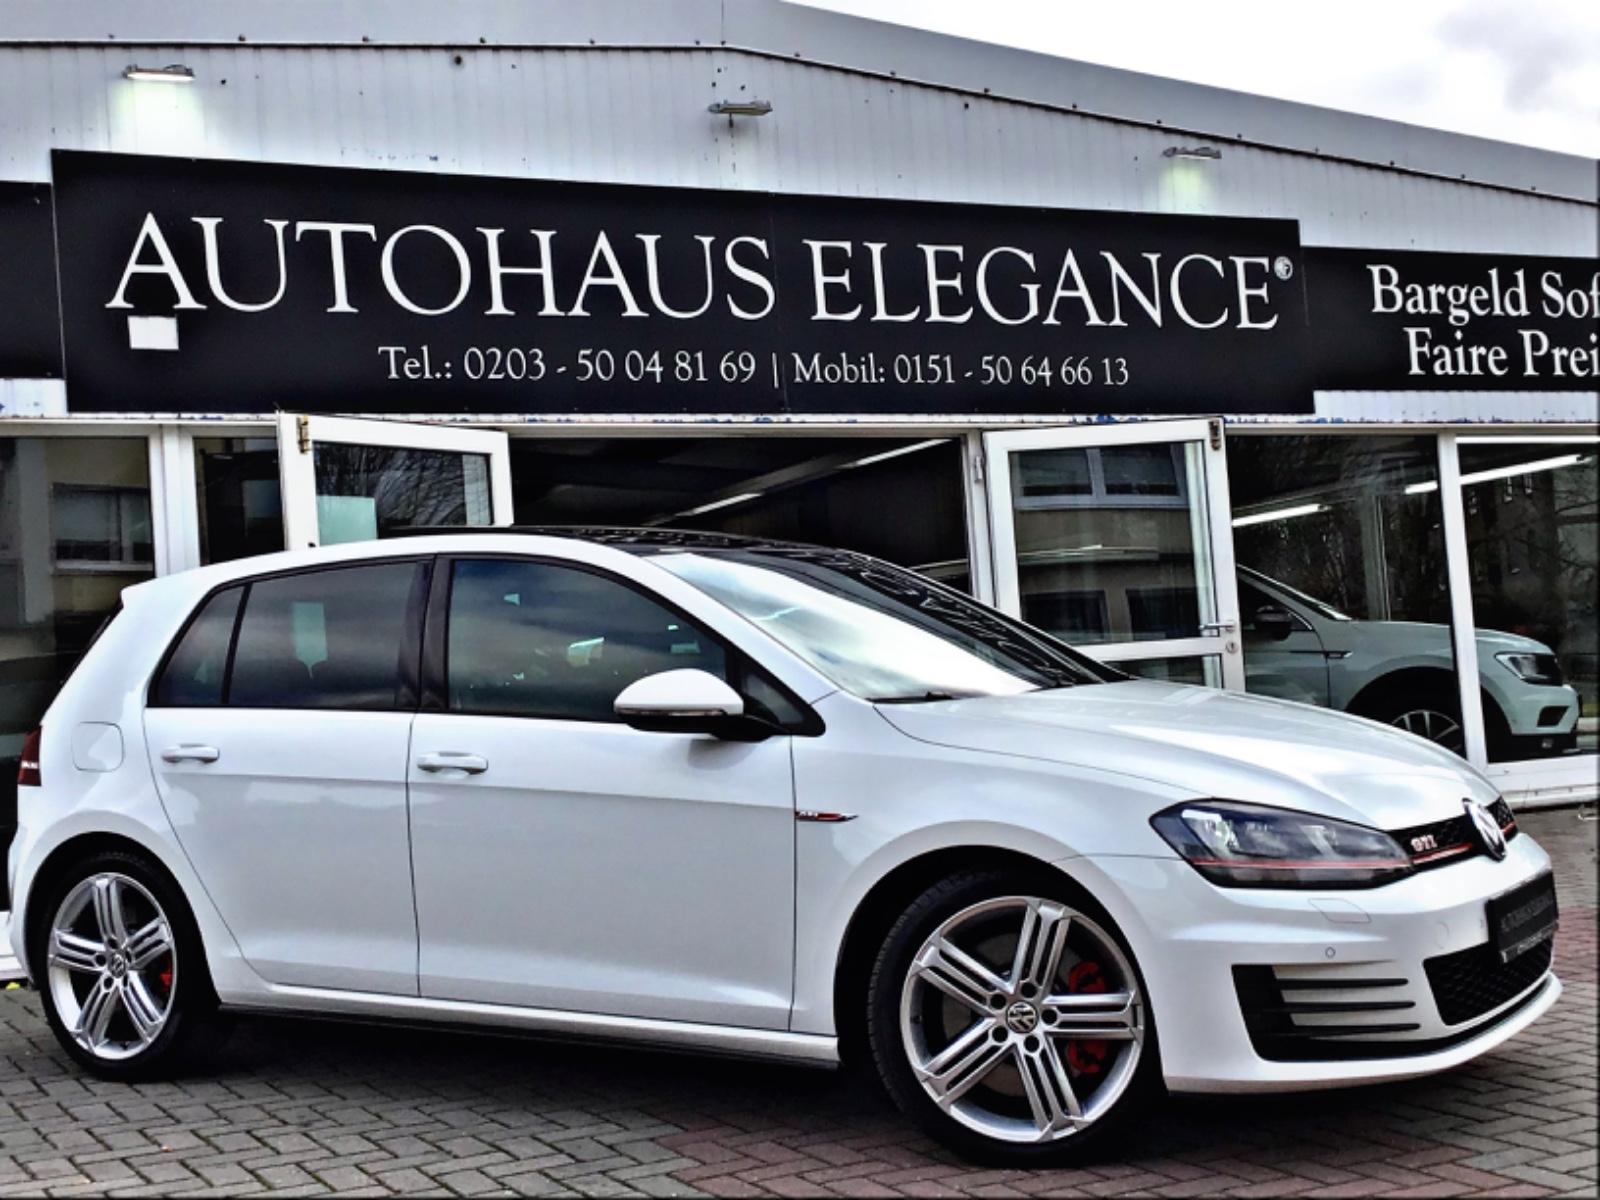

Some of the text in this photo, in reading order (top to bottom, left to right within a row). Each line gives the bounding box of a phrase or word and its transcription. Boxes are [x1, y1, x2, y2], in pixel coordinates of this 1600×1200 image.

[105, 212, 775, 320] AUTOHAUS
[1366, 264, 1531, 327] Bargeld
[377, 346, 452, 379] Tel.:
[464, 346, 546, 380] 0203
[576, 348, 615, 381] 50
[625, 350, 664, 383] 04
[674, 350, 708, 382] 81
[719, 350, 756, 383] 69
[791, 352, 885, 383] Mobil:
[894, 354, 955, 385] 0151
[981, 355, 1013, 385] 50
[1021, 356, 1053, 387] 64
[1060, 356, 1093, 385] 66
[1102, 357, 1129, 385] 13
[1403, 327, 1600, 377] Faire Prei
